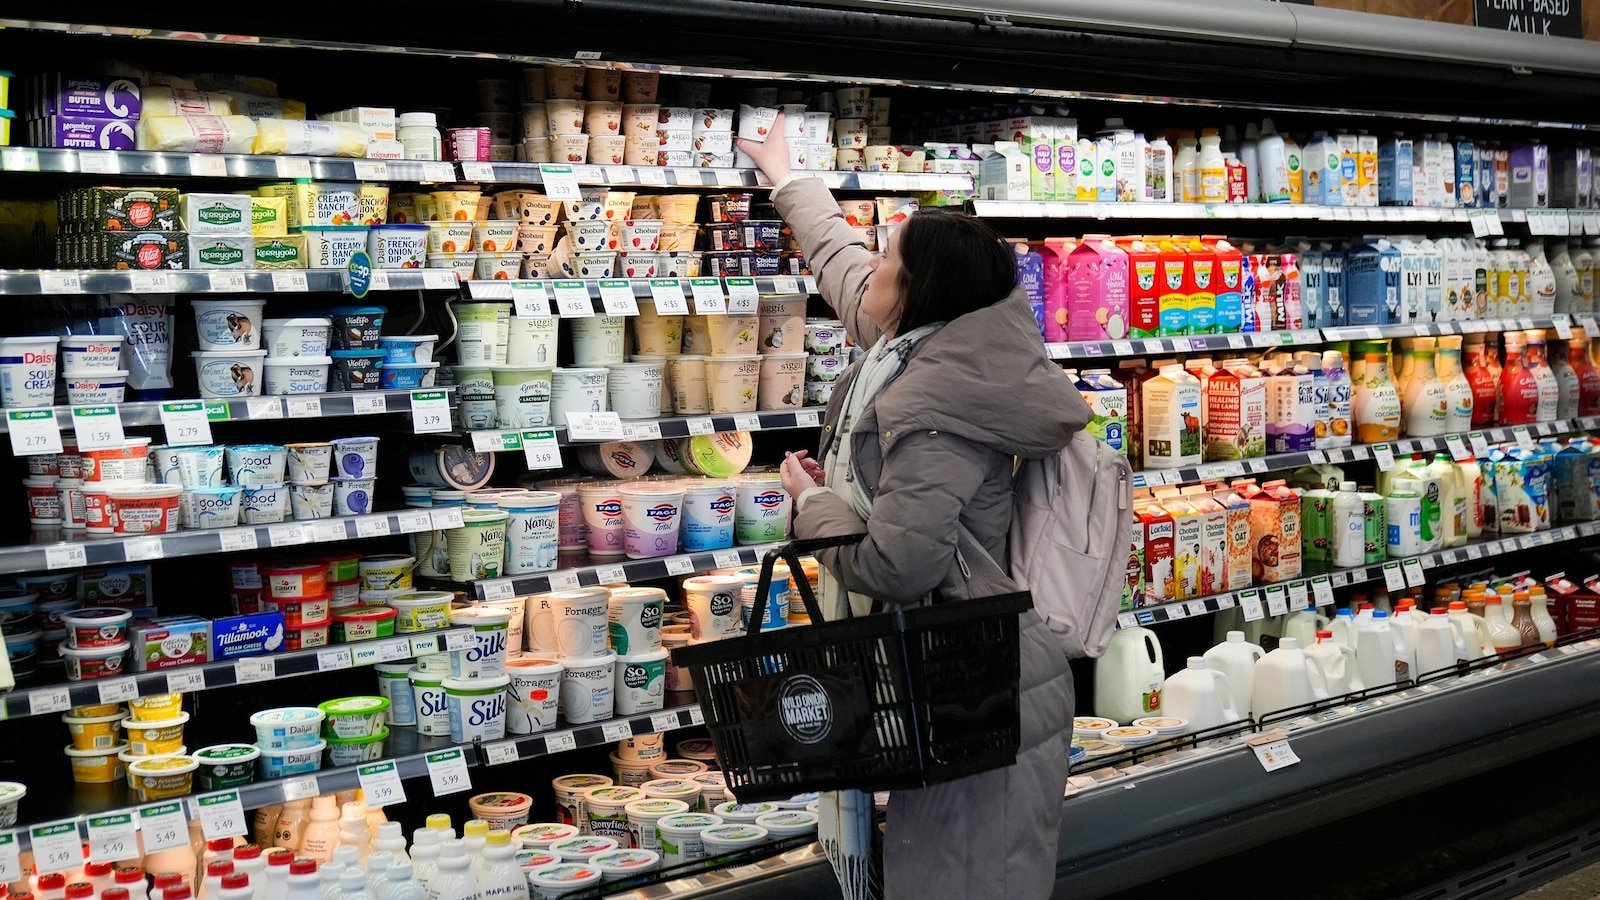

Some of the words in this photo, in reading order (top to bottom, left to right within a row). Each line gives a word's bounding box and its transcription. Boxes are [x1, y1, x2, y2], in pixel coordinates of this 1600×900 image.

[1486, 0, 1570, 16] PLANT-BASED
[1507, 14, 1551, 36] MILK
[68, 97, 101, 105] BUTTER
[63, 122, 96, 133] Meyenberg
[64, 139, 96, 148] BUTTER
[555, 186, 570, 194] 2.39
[318, 194, 350, 203] CREAMY
[308, 191, 316, 218] Daisy
[318, 203, 345, 211] RANCH
[526, 201, 551, 209] Chobani
[130, 208, 150, 219] Vital
[318, 211, 332, 219] DIP
[519, 231, 544, 240] Chobani
[332, 241, 361, 250] CREAMY
[388, 240, 417, 248] FRENCH
[139, 250, 159, 261] Vital
[321, 238, 330, 265] Daisy
[388, 255, 401, 263] DIP
[1307, 273, 1320, 288] LY!
[1328, 273, 1341, 287] LY!
[1385, 272, 1399, 286] LY!
[1408, 272, 1421, 286] LY!
[1428, 272, 1440, 285] LY!
[525, 303, 540, 311] 4/$5
[567, 302, 583, 310] 4/$5
[612, 301, 628, 309] 4/$5
[663, 299, 679, 307] 4/$5
[703, 299, 717, 307] 4/$5
[736, 299, 750, 307] 4/$5
[1245, 285, 1253, 323] MILK
[1277, 283, 1285, 322] MILK
[125, 302, 166, 319] Daisy
[345, 316, 369, 326] Violife
[131, 321, 165, 333] SOUR
[302, 329, 326, 338] Forager
[126, 333, 169, 346] CREAM
[87, 344, 113, 354] Daisy
[301, 344, 320, 352] Sour
[24, 352, 56, 365] Daisy
[347, 359, 371, 368] Violife
[29, 371, 55, 380] SOUR
[290, 368, 319, 377] Forager
[24, 380, 55, 390] CREAM
[74, 380, 100, 390] Daisy
[1210, 381, 1238, 390] MILK
[1298, 387, 1313, 397] Goat
[1101, 396, 1124, 405] ORGANIC
[1299, 395, 1313, 404] Milk
[1104, 402, 1123, 410] VALLEY
[424, 415, 440, 425] 3.79
[91, 431, 110, 441] 1.59
[178, 427, 198, 437] 2.79
[25, 436, 47, 446] 2.79
[243, 455, 271, 467] good
[536, 453, 551, 462] 5.69
[702, 447, 715, 468] 2%
[244, 492, 276, 505] good
[199, 498, 233, 510] good
[761, 509, 779, 517] Total
[717, 514, 731, 523] Total
[525, 516, 556, 532] Nancy's
[654, 522, 672, 531] Total
[764, 523, 777, 534] 2%
[1206, 523, 1225, 531] Chobani
[1284, 524, 1295, 532] OAT
[720, 529, 729, 539] 5%
[1150, 525, 1171, 534] Lactaid
[1179, 526, 1200, 535] Chobani
[1207, 529, 1224, 537] Oatmilk
[1180, 534, 1199, 542] Oatmilk
[1235, 532, 1247, 541] OAT
[655, 538, 669, 547] 0%
[565, 607, 602, 615] Forager
[217, 626, 269, 645] Tillamook
[161, 637, 192, 649] ORGANIC
[416, 641, 433, 649] new
[466, 632, 505, 661] Silk
[168, 646, 187, 655] VALLEY
[357, 649, 375, 658] new
[178, 657, 195, 665] Cheese
[565, 669, 602, 679] Forager
[515, 678, 553, 688] Forager
[781, 696, 802, 710] WILD
[803, 693, 825, 706] ONION
[468, 692, 505, 726] Silk
[784, 704, 828, 725] MARKET
[290, 725, 312, 736] Daiya
[288, 753, 311, 764] Daiya
[442, 775, 459, 786] 5.99
[375, 787, 392, 798] 5.99
[214, 820, 233, 831] 5.49
[590, 820, 628, 830] Stonyfield
[156, 831, 176, 843] 5.49
[595, 829, 624, 838] ORGANIC
[103, 843, 124, 854] 5.49
[48, 852, 71, 864] 5.49
[485, 886, 511, 896] MAPLE
[513, 884, 526, 894] HILL
